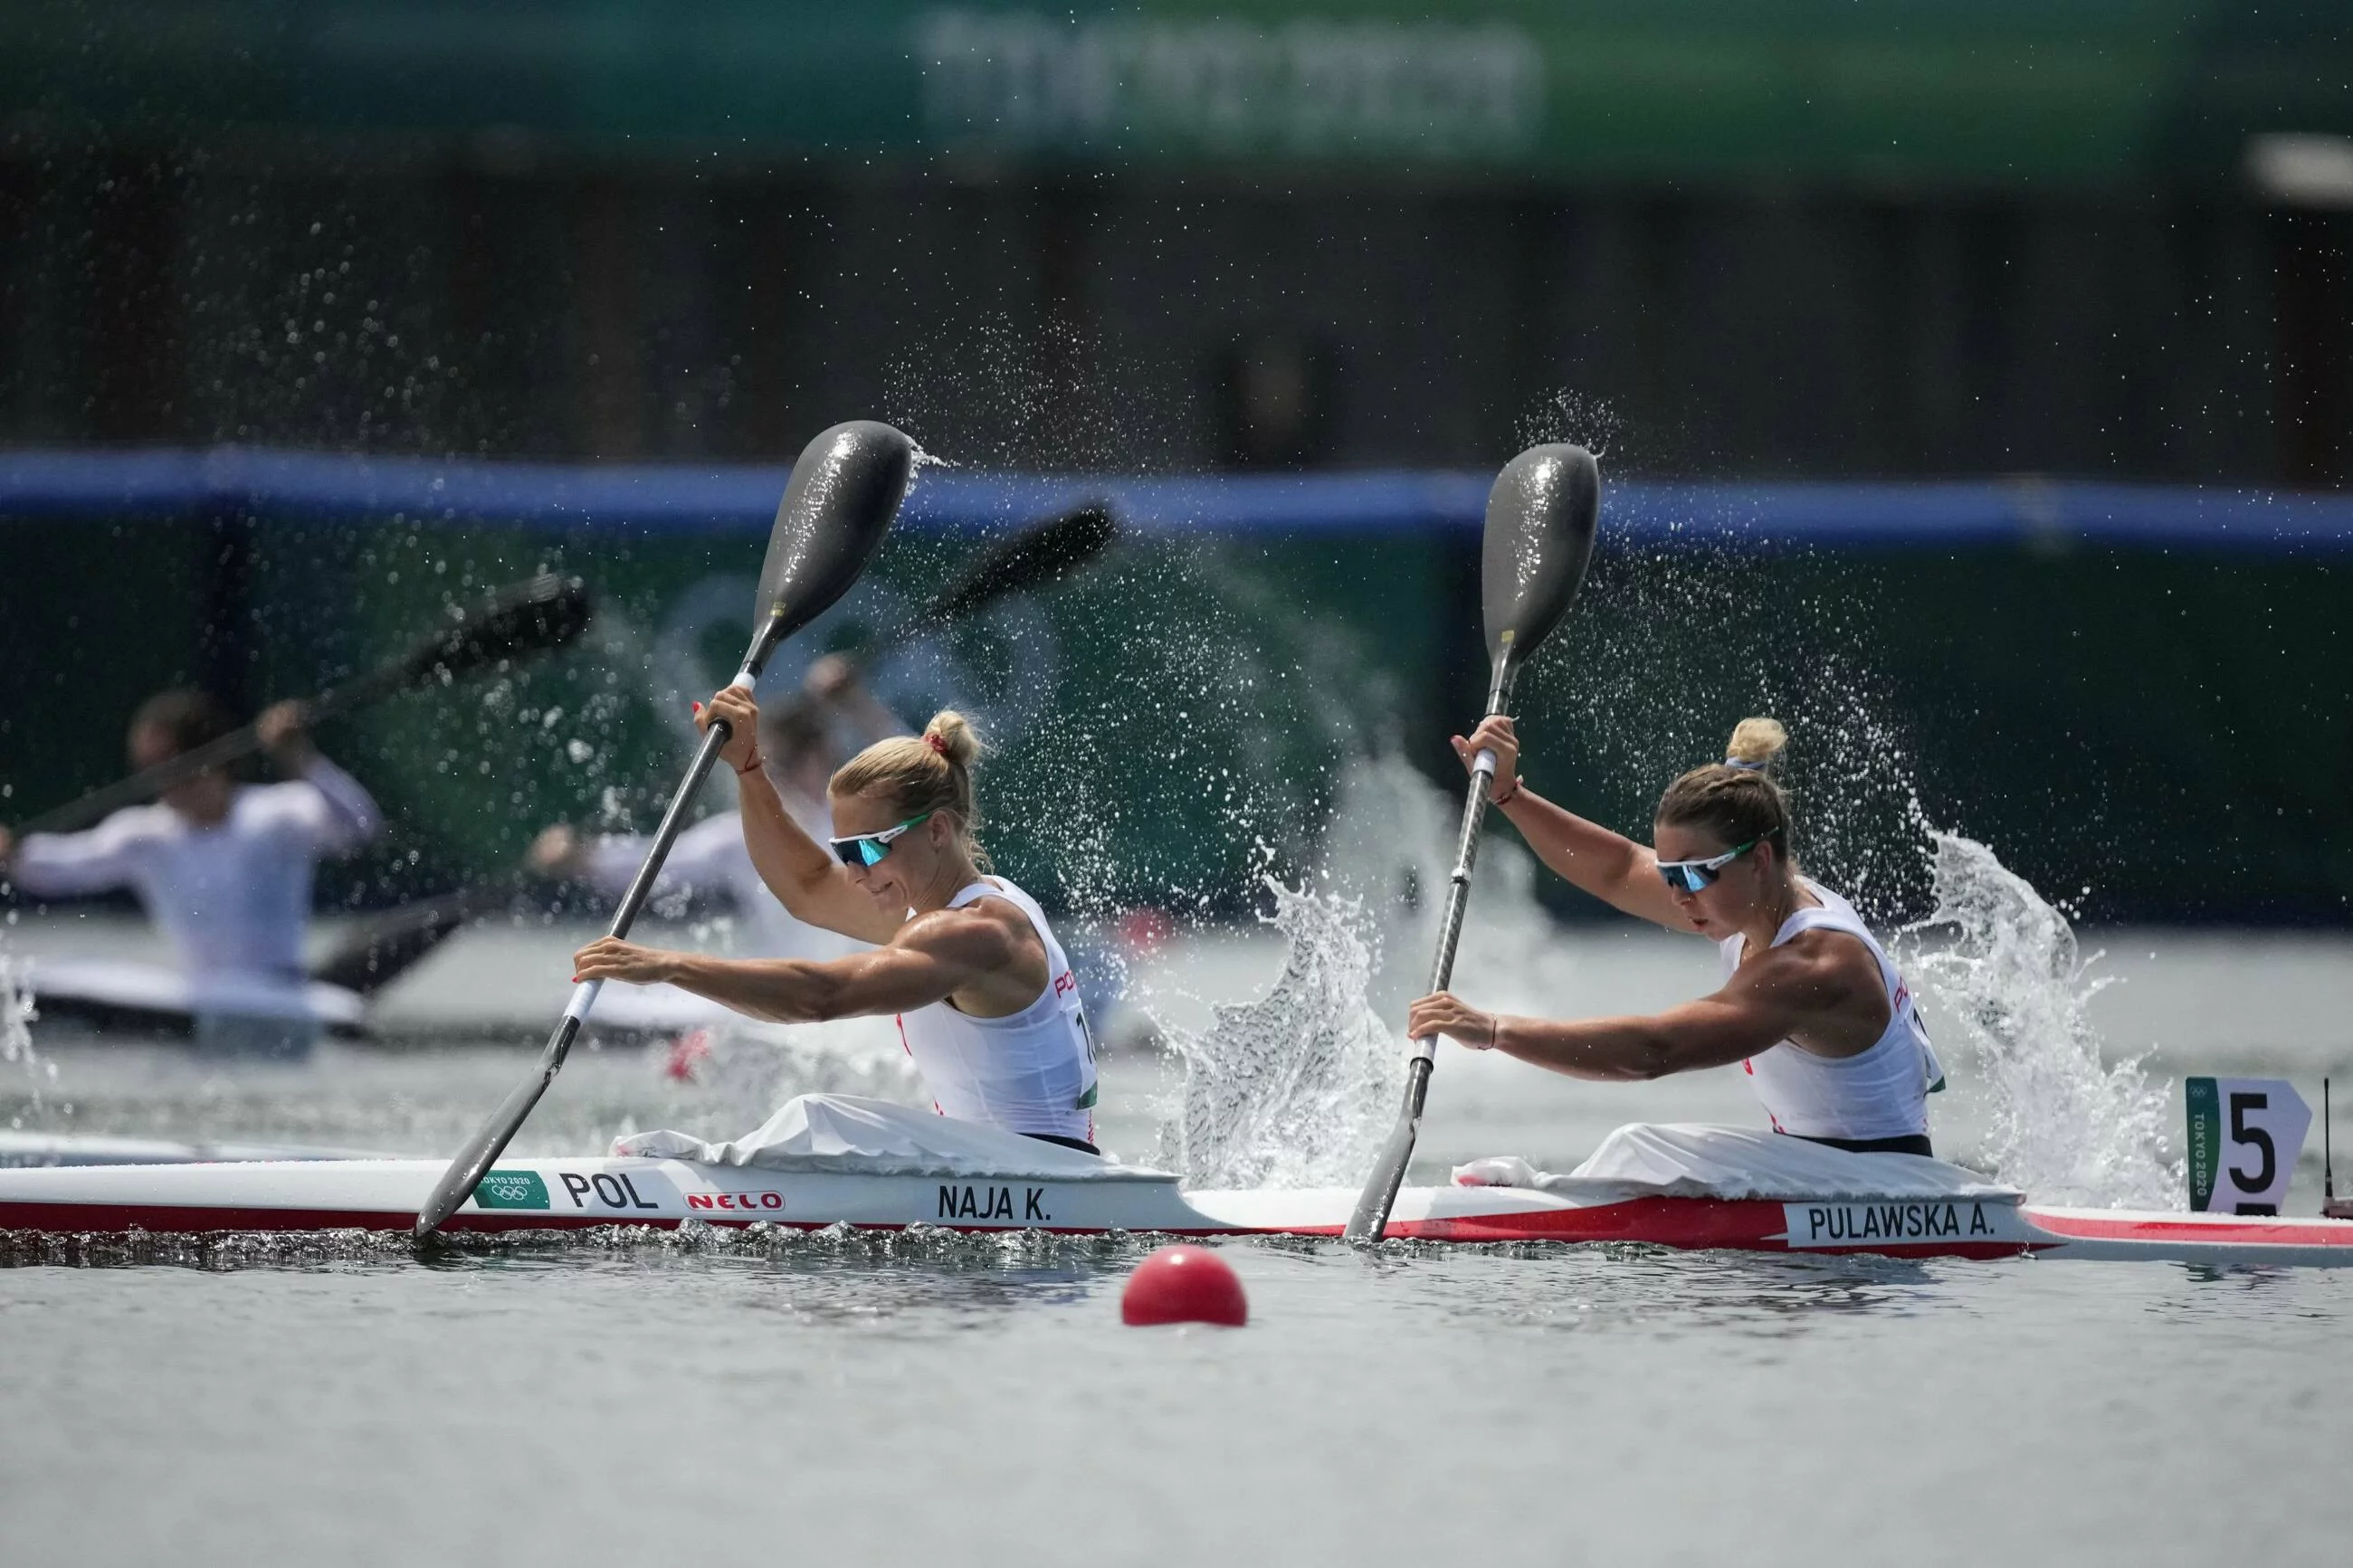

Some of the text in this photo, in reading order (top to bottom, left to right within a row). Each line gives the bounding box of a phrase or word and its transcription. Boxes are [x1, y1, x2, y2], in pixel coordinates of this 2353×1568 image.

[2194, 1112, 2207, 1196] TOKYO 2020
[2228, 1092, 2276, 1194] 5
[481, 1176, 530, 1185] OKYO 2020
[558, 1173, 660, 1209] POL
[687, 1193, 783, 1210] NELO
[938, 1184, 1052, 1221] NAJA K.
[1808, 1202, 1996, 1240] PULAWSKA A.
